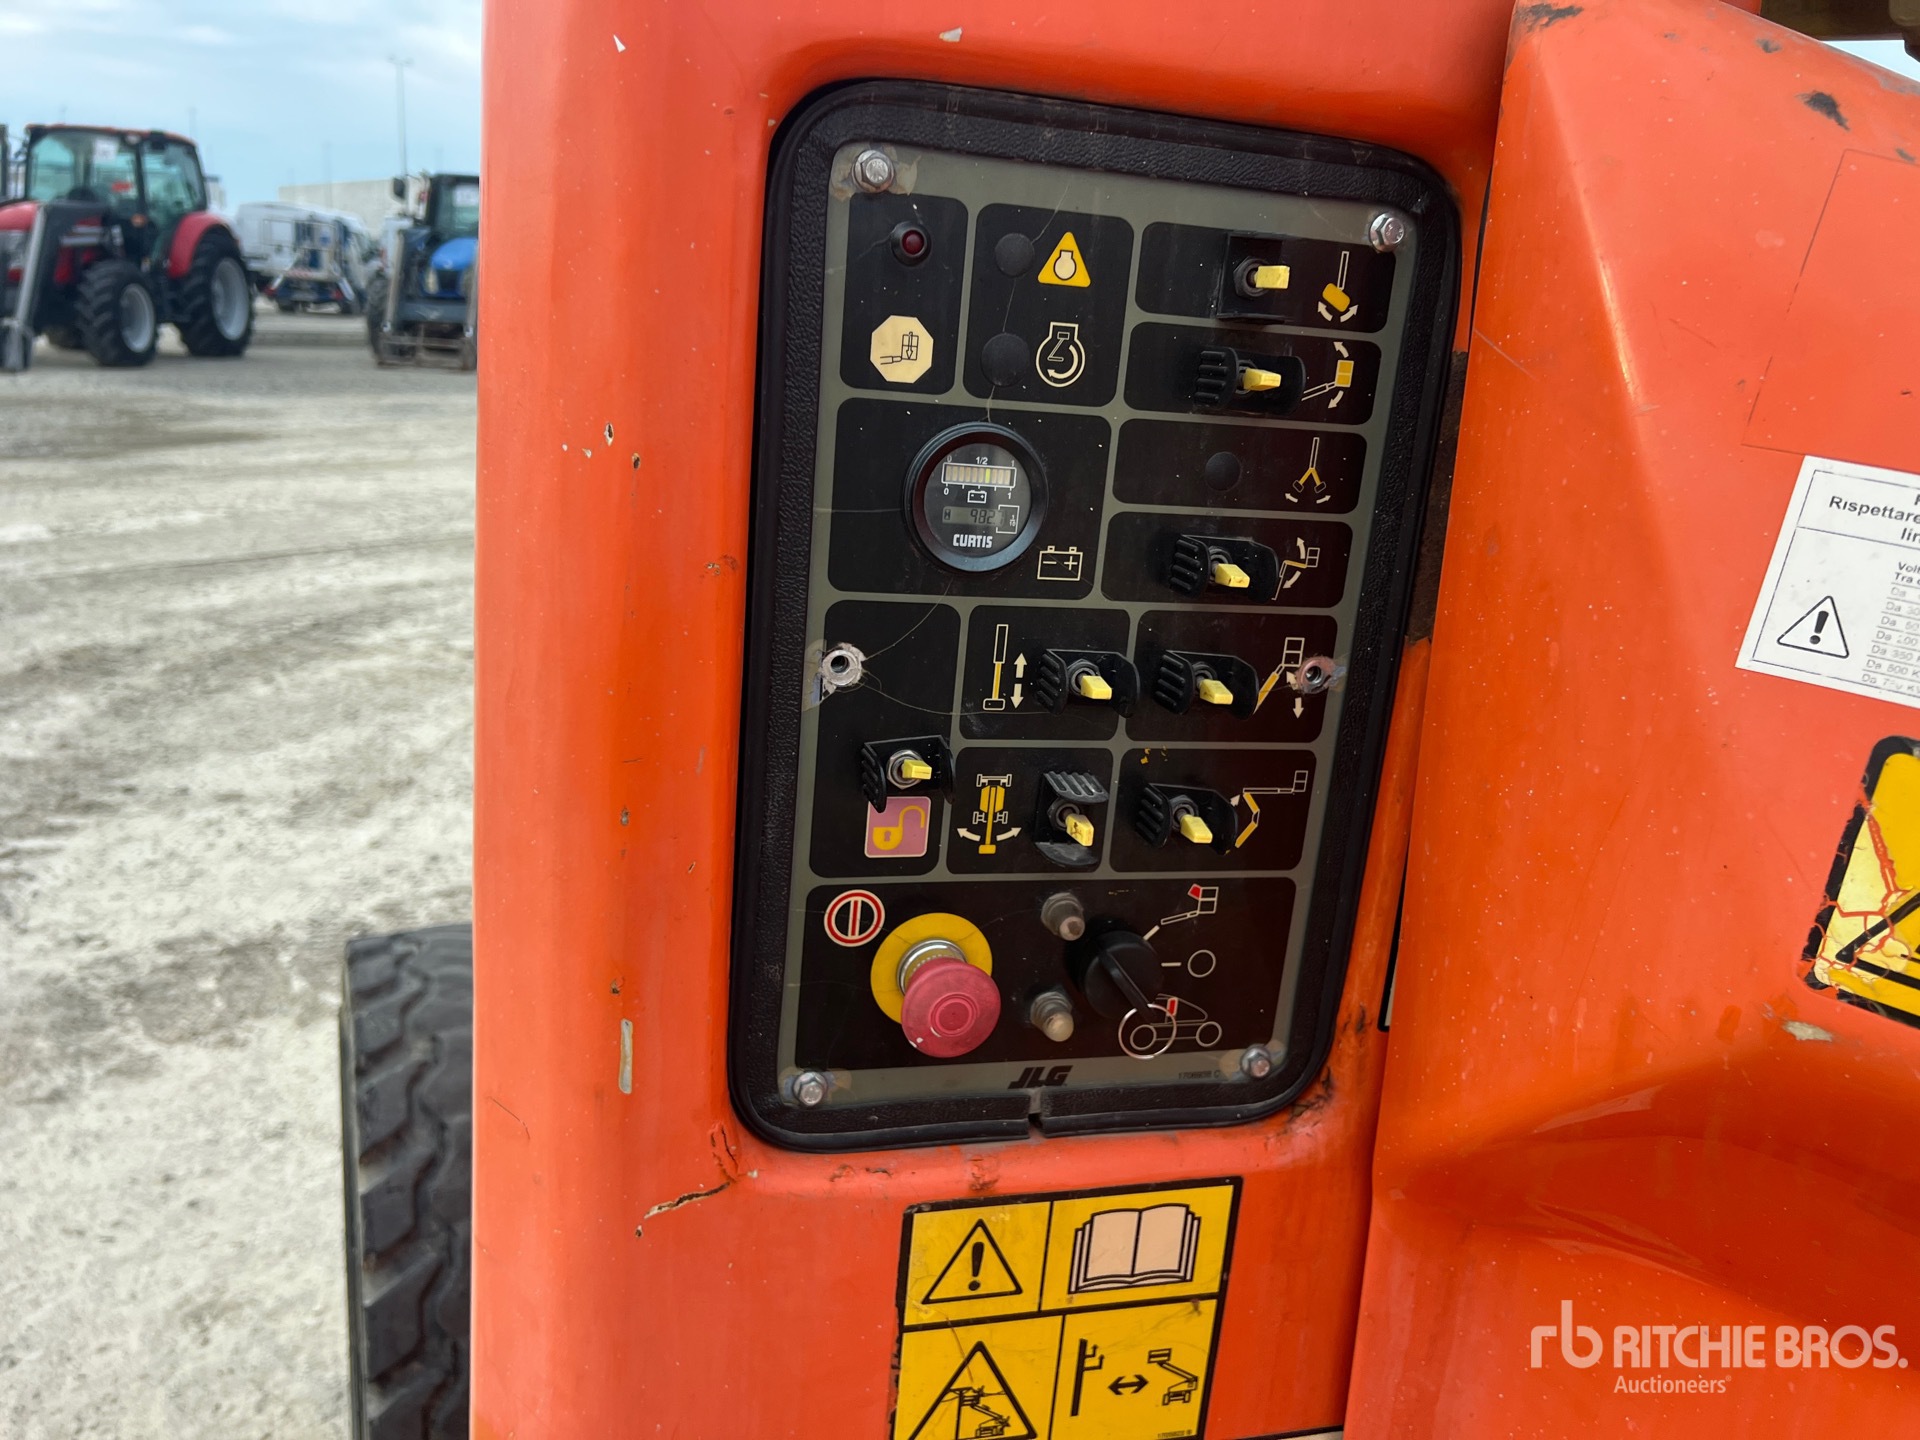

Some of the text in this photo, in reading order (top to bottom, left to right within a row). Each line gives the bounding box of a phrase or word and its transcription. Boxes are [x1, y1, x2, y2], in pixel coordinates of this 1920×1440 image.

[975, 456, 988, 465] 1/2
[944, 487, 1012, 500] 0 1
[1828, 495, 1920, 525] Rispettare
[953, 534, 993, 548] CURTIS
[1894, 572, 1913, 584] Tra
[1885, 601, 1902, 613] Da
[1880, 615, 1897, 627] Da
[1875, 630, 1892, 642] Da
[1871, 644, 1888, 656] Da
[1866, 658, 1882, 670] Da
[1861, 673, 1877, 684] Da
[1008, 1064, 1074, 1090] JLG
